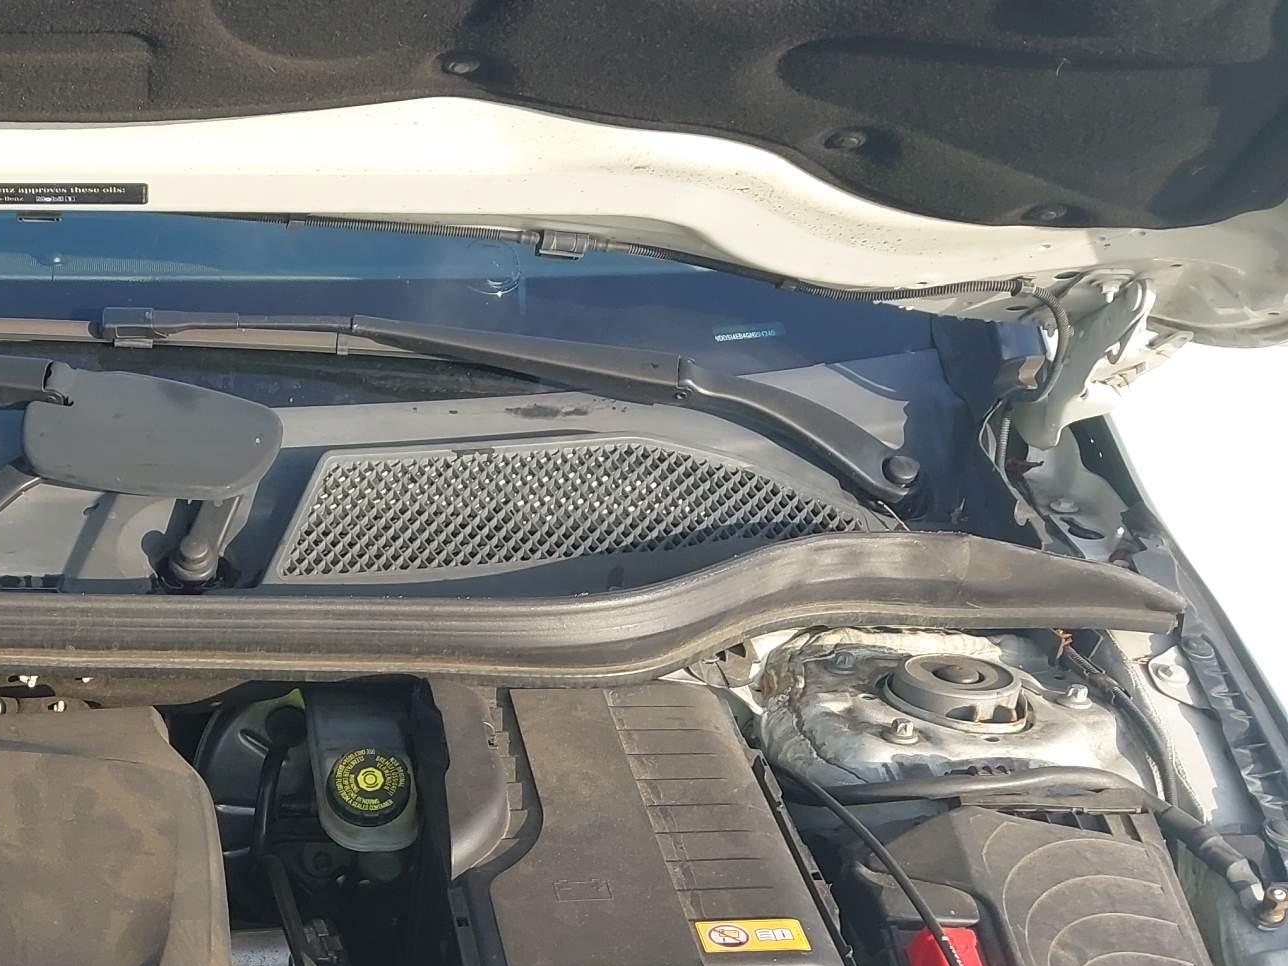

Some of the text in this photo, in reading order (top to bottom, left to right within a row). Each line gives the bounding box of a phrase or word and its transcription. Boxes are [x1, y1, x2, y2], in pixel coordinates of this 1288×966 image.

[18, 186, 67, 195] approves
[70, 186, 100, 194] these
[102, 186, 126, 194] oils:
